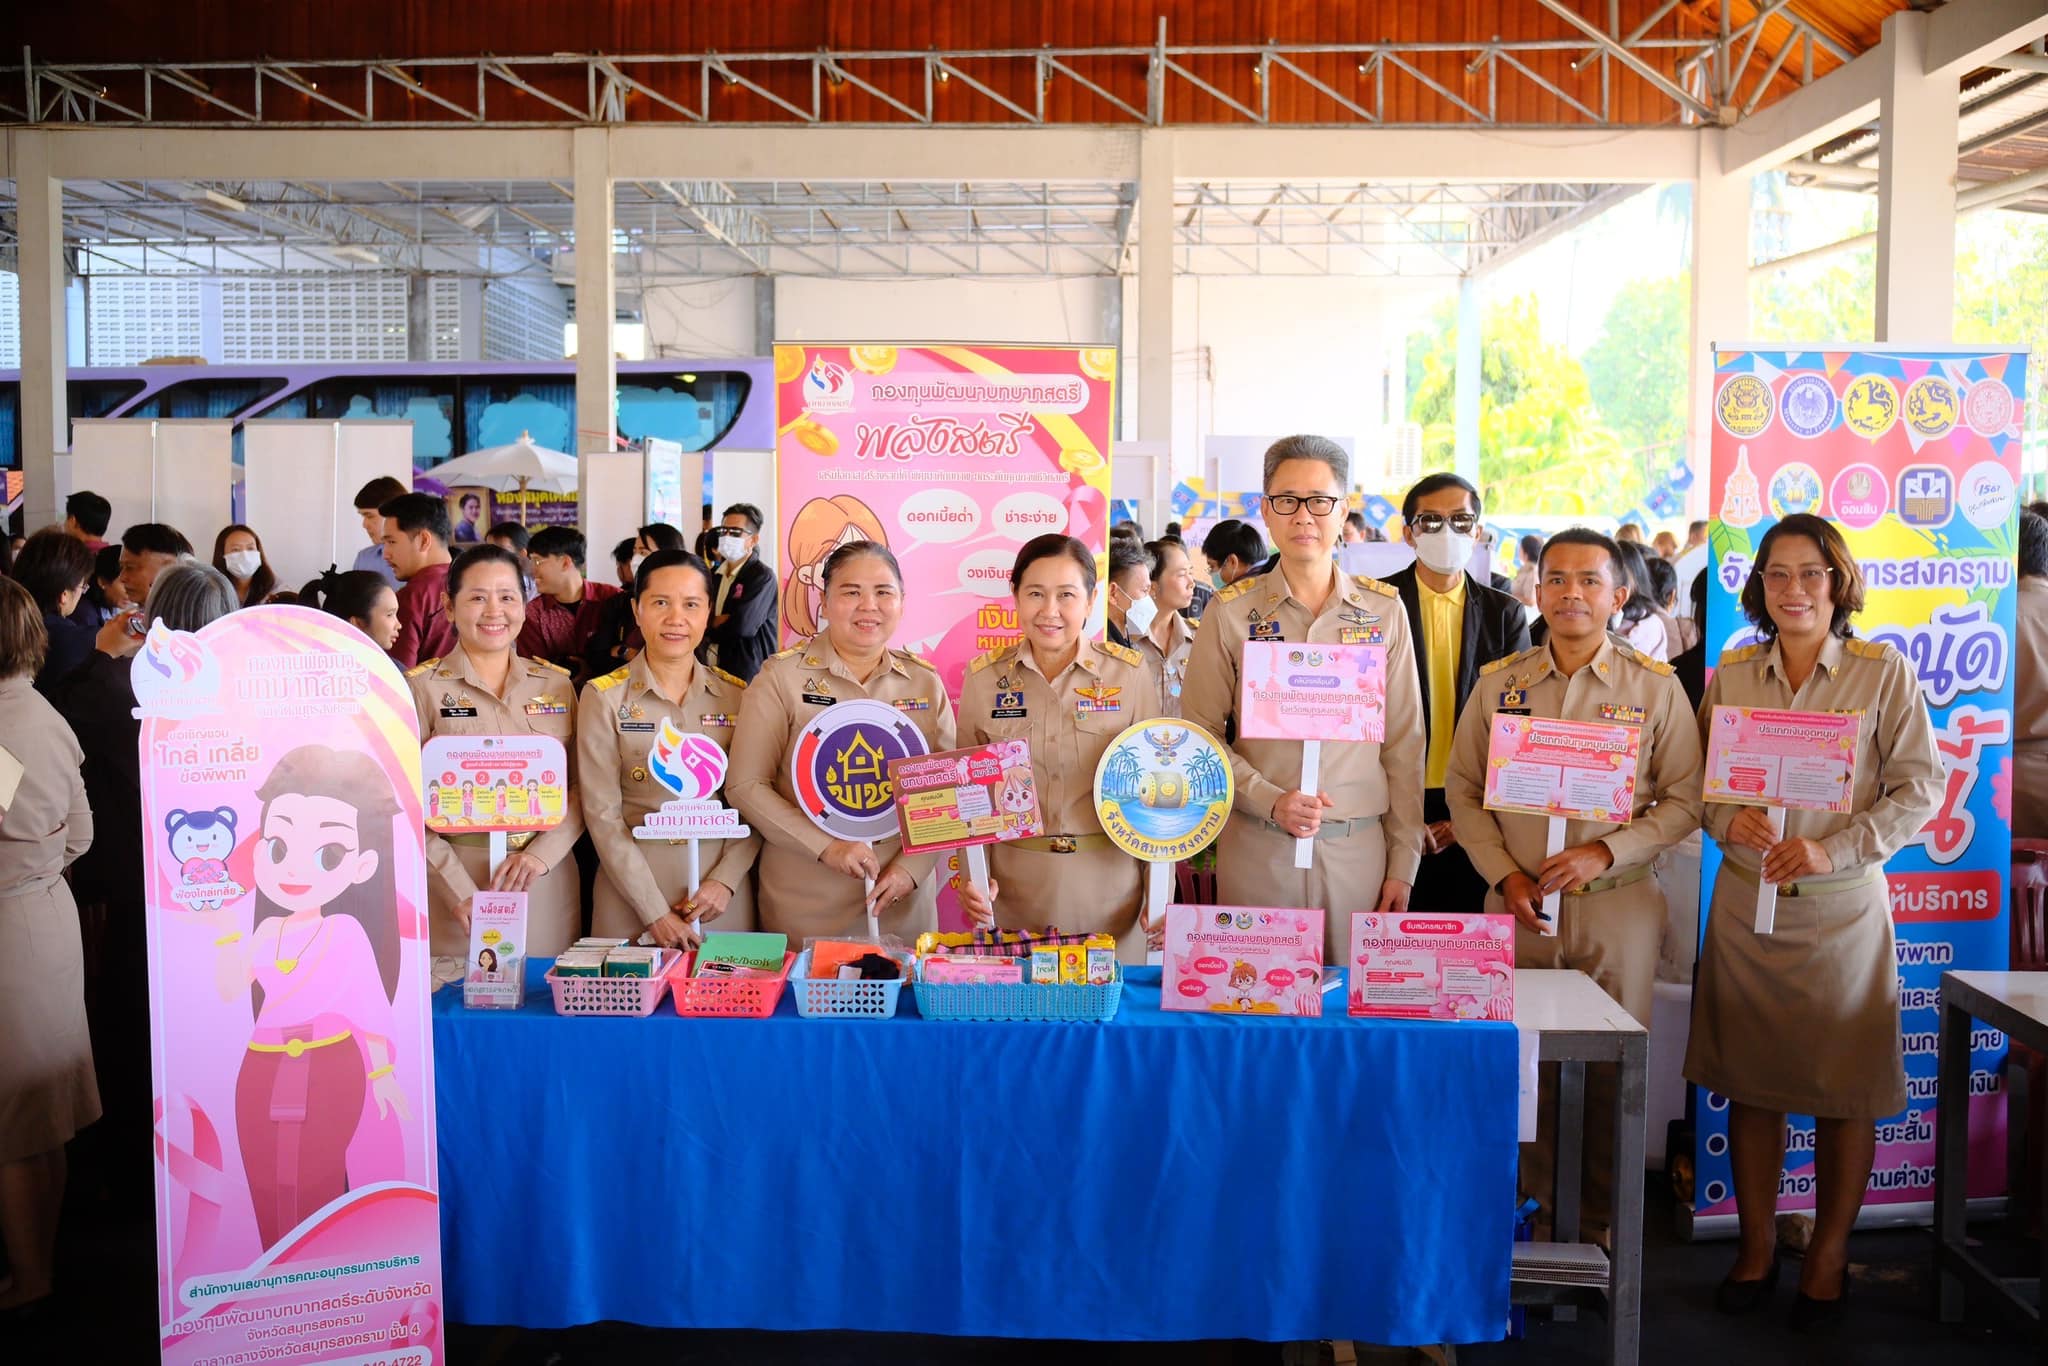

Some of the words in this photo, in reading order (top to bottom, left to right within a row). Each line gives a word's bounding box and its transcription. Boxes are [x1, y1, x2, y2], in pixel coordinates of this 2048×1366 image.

[872, 381, 1081, 406] กองทุนพัฒนาบทบาทสตรี
[857, 412, 1033, 458] พลังสตรี
[907, 506, 974, 523] ดอกเบี้ยต่ำ
[1005, 510, 1058, 525] ชำระง่าย
[1841, 502, 1878, 515] ออมสิน
[158, 743, 198, 766] ไกล่
[209, 736, 259, 763] เกลี่ย
[1530, 733, 1627, 752] ประเภทเงินทุนหมุนเวียน
[181, 768, 246, 783] ข้อพิพาท
[648, 812, 735, 826] บทบาทสตรี
[1107, 810, 1220, 857] จังหวัดสมุทรสงคราม
[1362, 936, 1501, 952] กองทุนพัฒนาบทบาทสตรี
[189, 1254, 420, 1298] สำนักงานเลขานุการคณะอนุกรรมการบริหาร
[172, 1281, 431, 1335] กองทุนพัฒนาบทบาทสตรีระดับจังหวัด
[247, 1313, 364, 1342] จังหวัดสมุทรสงคราม
[390, 1320, 407, 1338] ชั้น
[411, 1324, 420, 1336] 4
